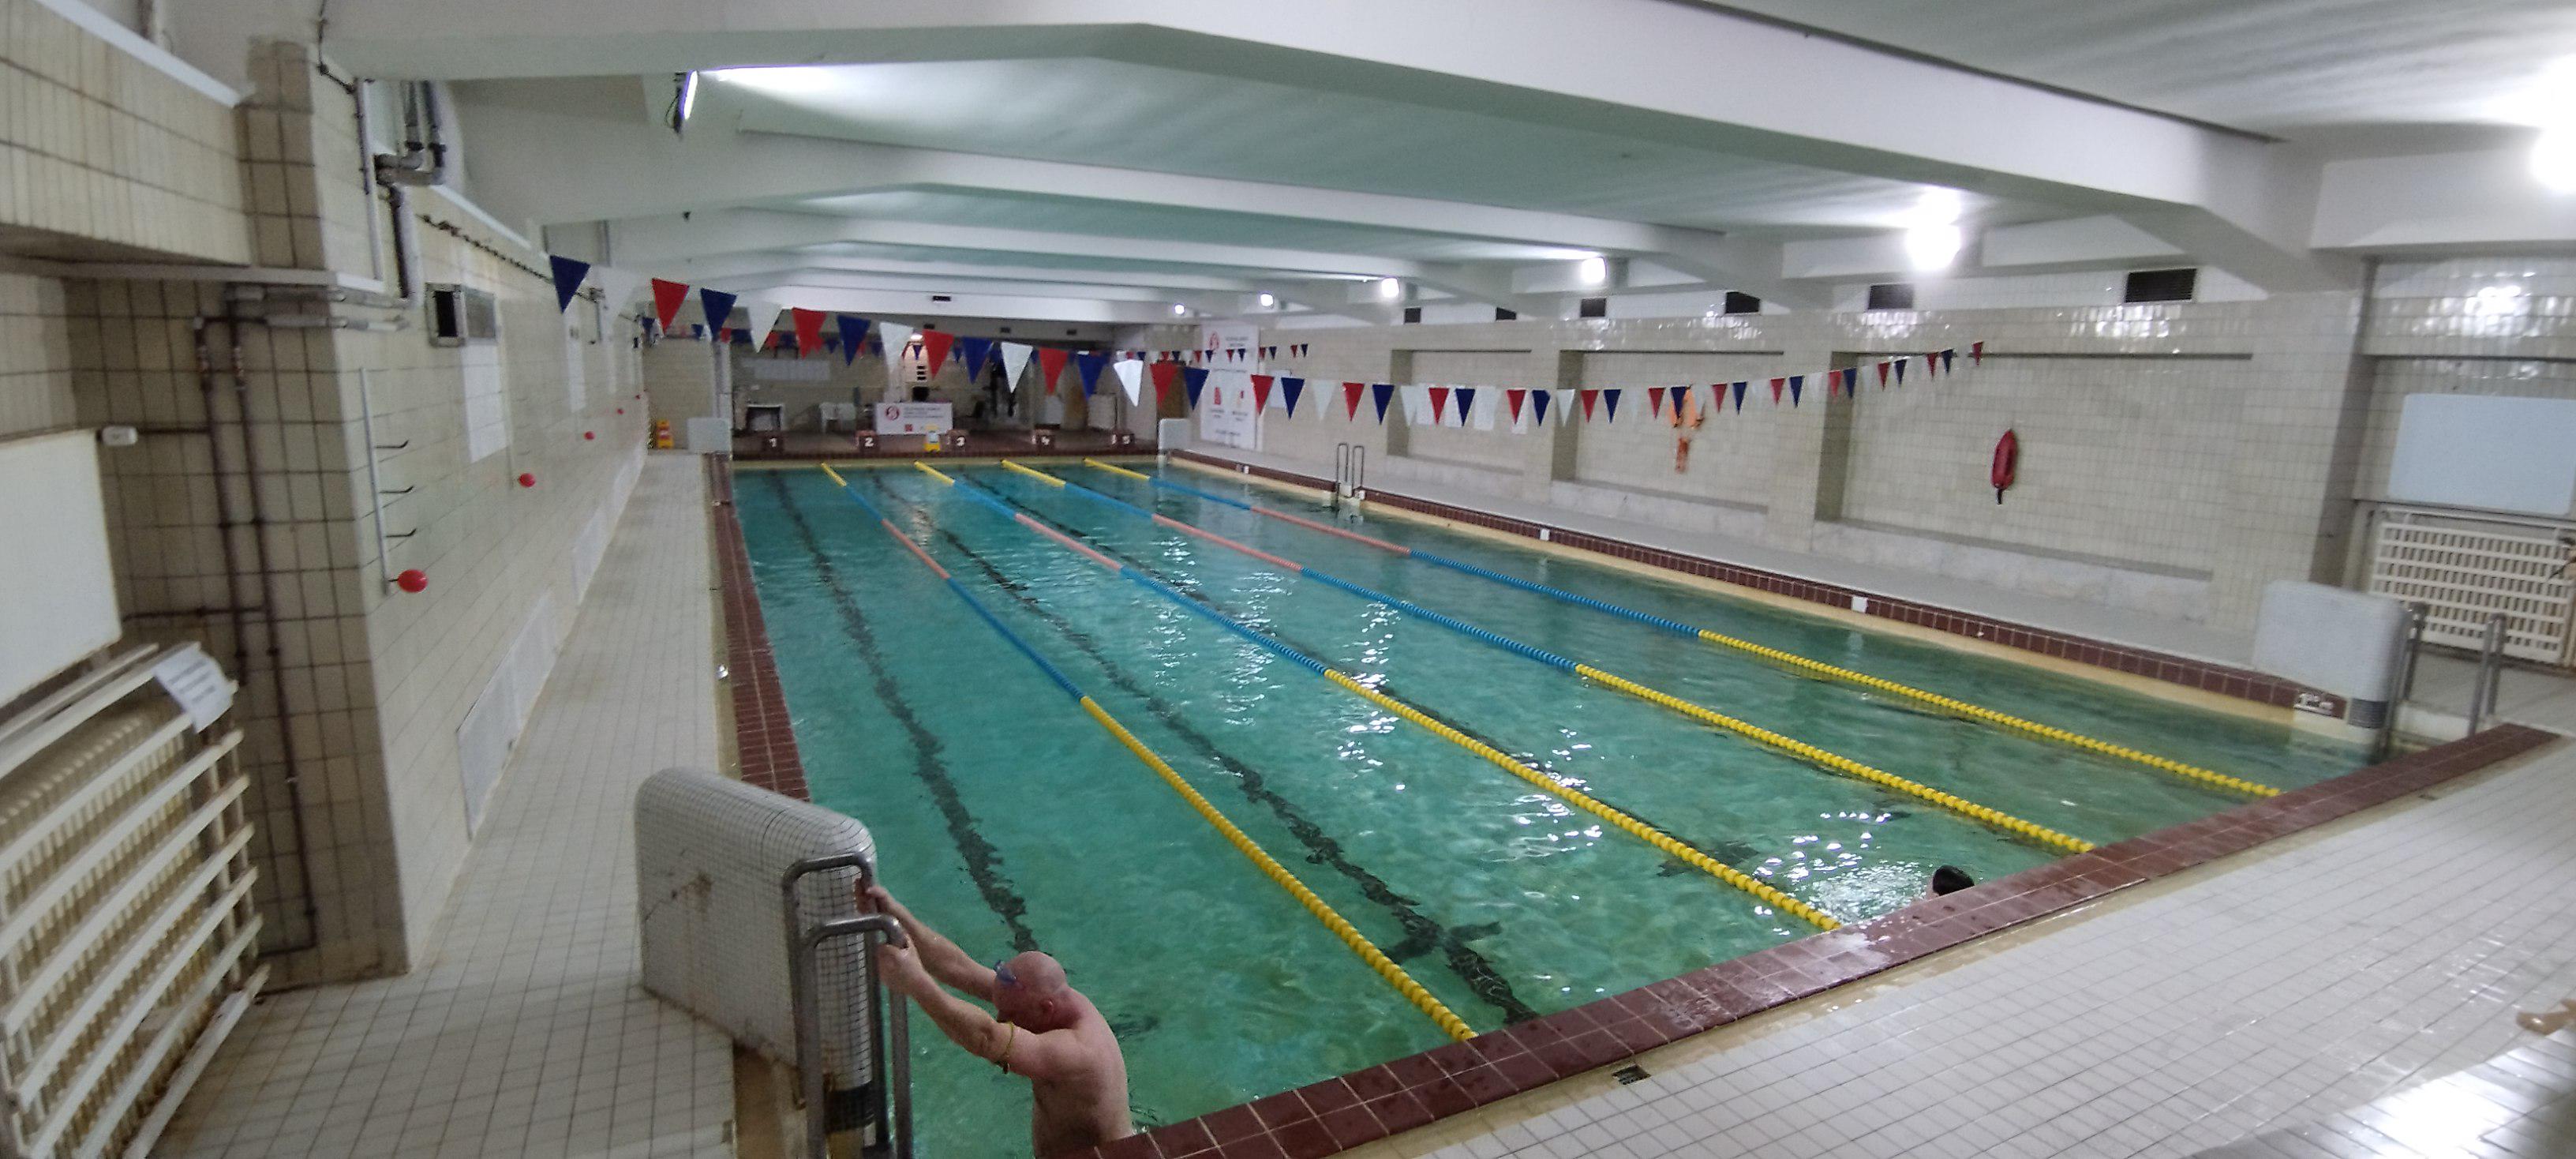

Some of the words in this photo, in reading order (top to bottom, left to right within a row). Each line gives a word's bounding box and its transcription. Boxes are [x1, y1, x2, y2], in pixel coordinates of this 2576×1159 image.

[769, 437, 777, 448] 1
[864, 437, 874, 447] 2
[957, 437, 965, 446] 3
[1042, 436, 1050, 445] 4
